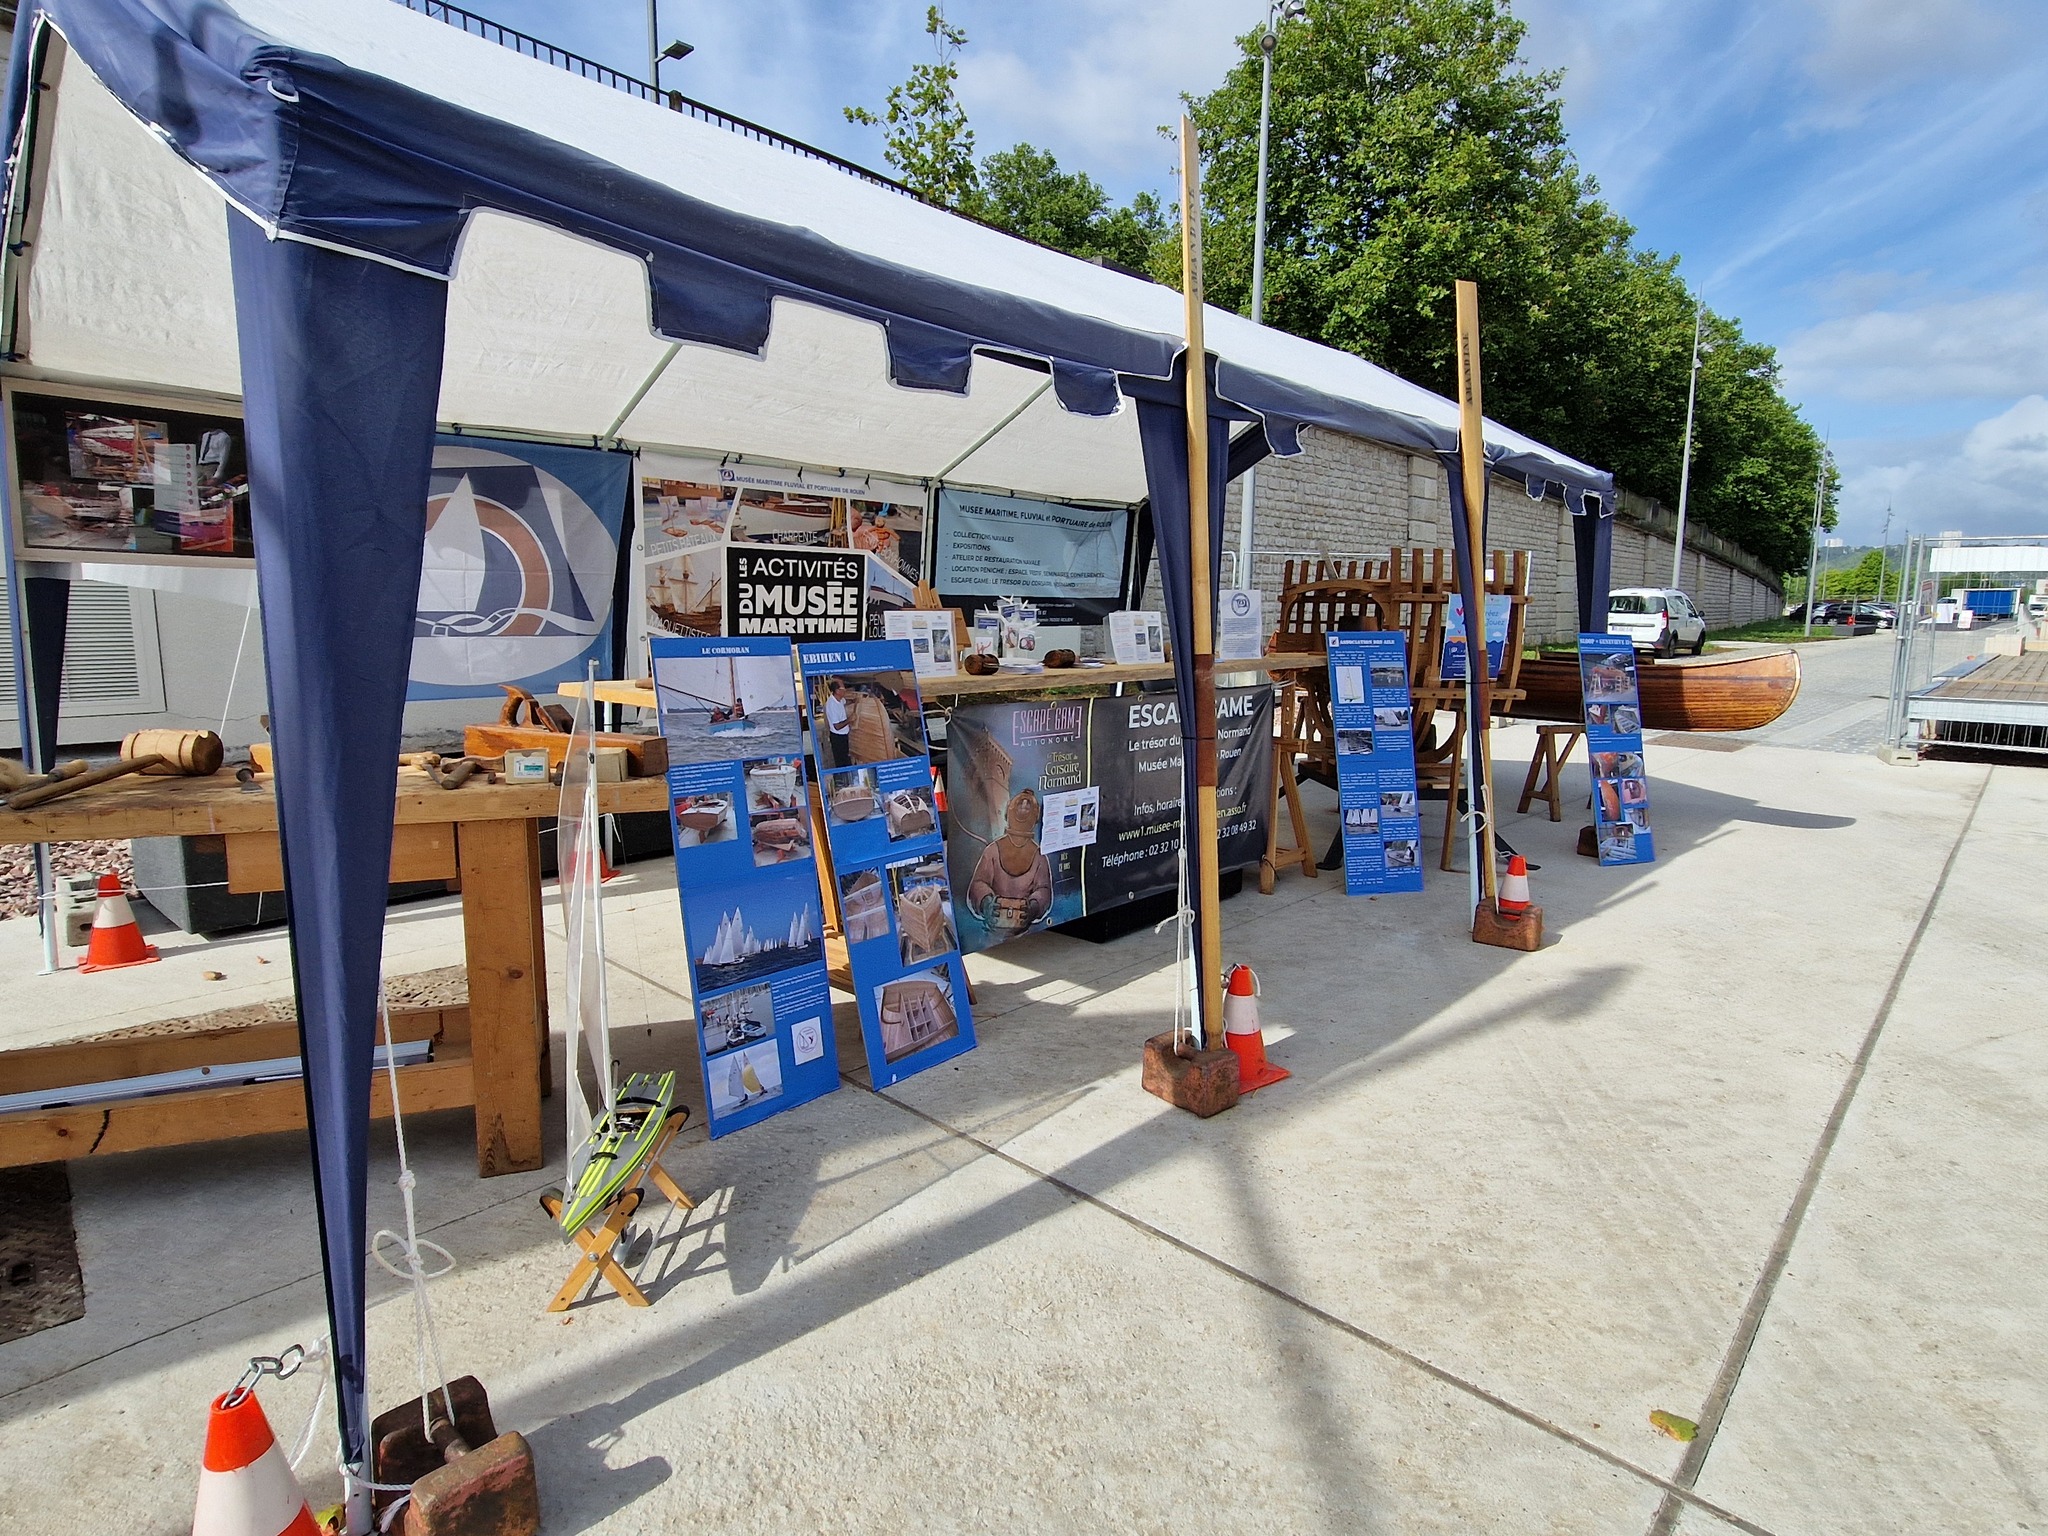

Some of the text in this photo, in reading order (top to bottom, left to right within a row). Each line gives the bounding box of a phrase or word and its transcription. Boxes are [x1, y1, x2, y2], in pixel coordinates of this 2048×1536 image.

[1462, 332, 1472, 405] AMANDINE
[736, 476, 756, 484] MUSÉE
[756, 478, 784, 487] MARITIME
[784, 482, 805, 490] FLUVIAL
[814, 484, 840, 493] PORTUAIRE
[959, 504, 983, 514] MUSEE
[1020, 512, 1044, 521] FLUVIAL
[1052, 516, 1088, 528] PORTUAIRE
[772, 529, 818, 544] CHARPENTE
[953, 531, 992, 540] COLLECTIONS
[953, 543, 990, 551] EXPOSITIONS
[984, 556, 1022, 564] RESTAURATION
[740, 557, 858, 580] LES ACTIVITÉS
[739, 581, 858, 616] DU MUSÉE
[739, 618, 858, 634] MARITIME
[712, 646, 750, 654] CORMORAN
[802, 652, 856, 664] EBIHEN 16
[1128, 695, 1254, 728] ESCA AME
[1012, 708, 1051, 746] ESCAPE
[1218, 725, 1252, 740] Normand
[1020, 736, 1074, 747] AUTONOME
[1128, 734, 1181, 752] Le trésor du
[1052, 752, 1073, 762] Trésor
[1220, 748, 1242, 760] Rouen
[1045, 762, 1080, 776] Corsaire
[1138, 758, 1168, 773] Musée
[1038, 770, 1081, 791] Normand
[1134, 804, 1155, 816] Infos,
[1216, 802, 1246, 818] en.asso.fr
[1118, 818, 1182, 842] www1.musee-m
[1222, 826, 1230, 838] 32
[1231, 824, 1239, 836] 08
[1239, 821, 1248, 832] 49
[1248, 819, 1256, 830] 32
[1102, 849, 1144, 868] Téléphone
[1150, 844, 1158, 856] 02
[1160, 841, 1169, 854] 32
[1170, 838, 1179, 850] 10
